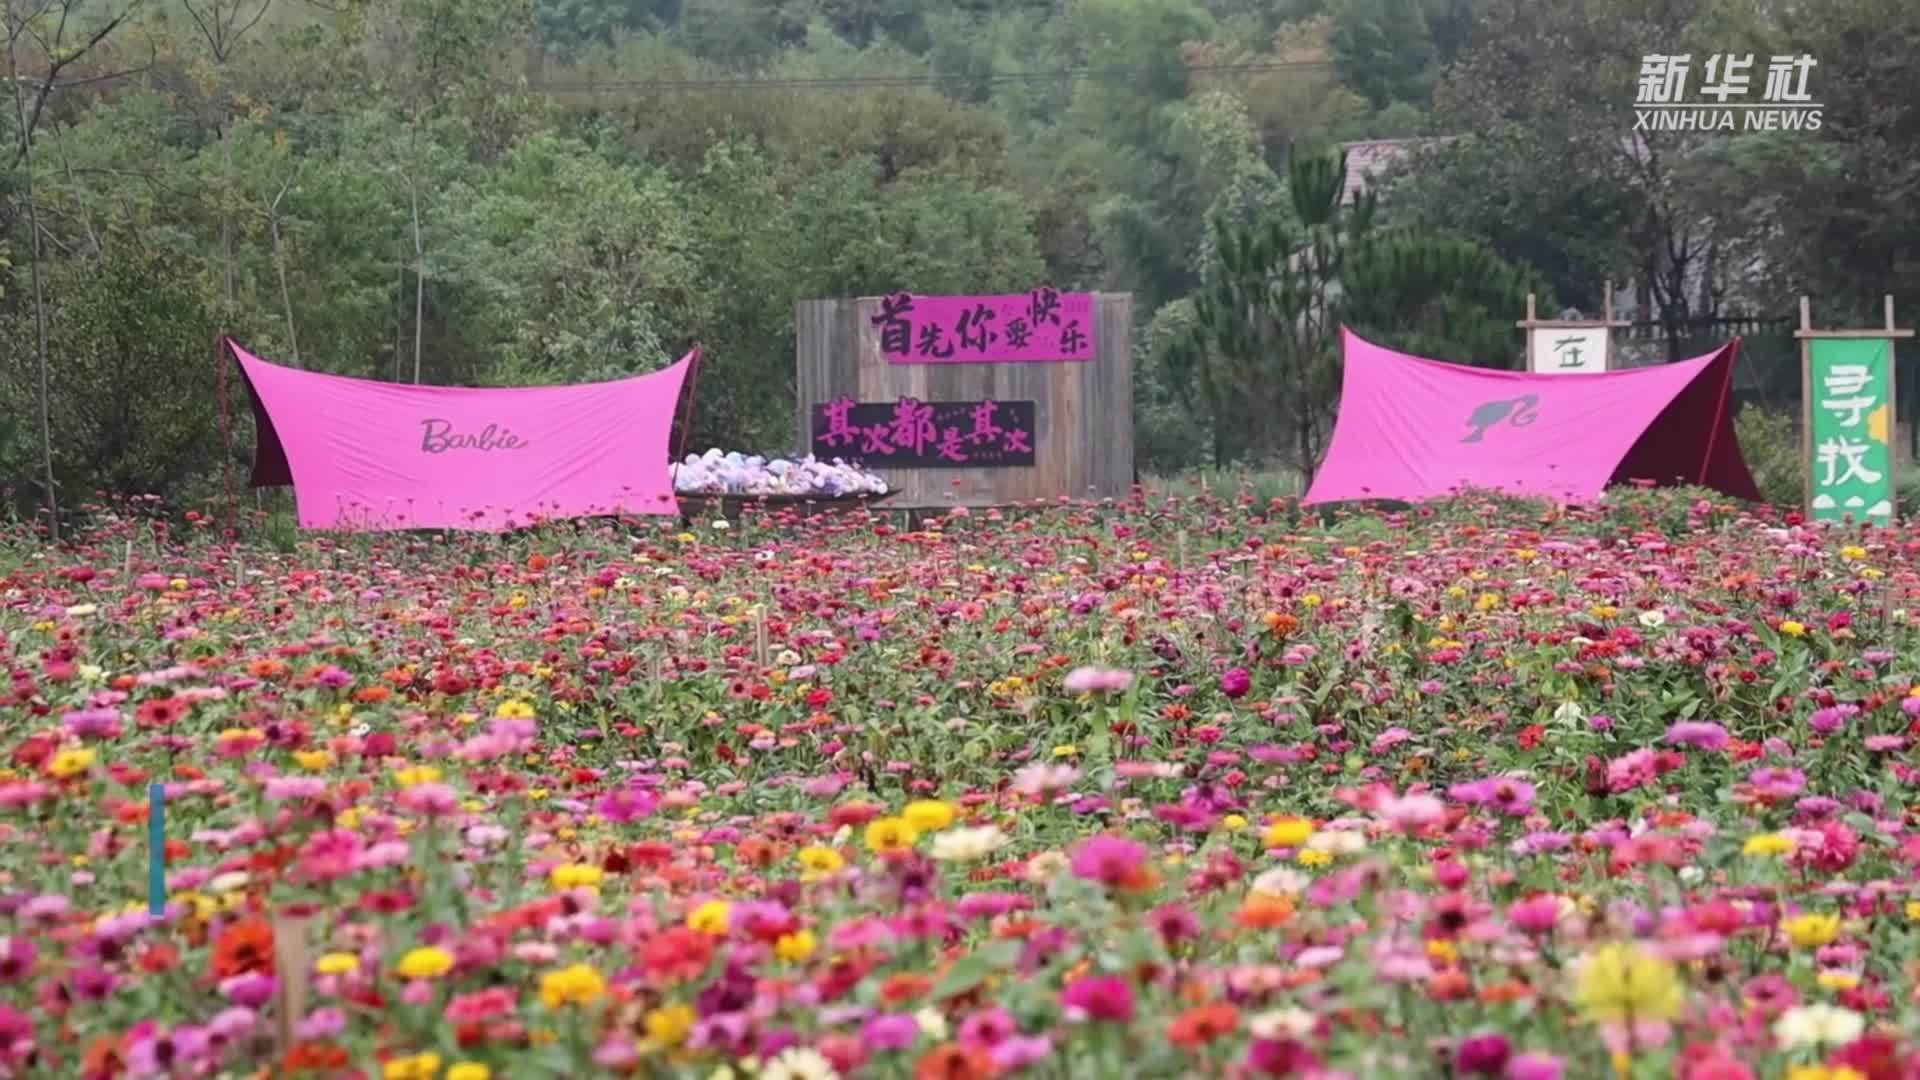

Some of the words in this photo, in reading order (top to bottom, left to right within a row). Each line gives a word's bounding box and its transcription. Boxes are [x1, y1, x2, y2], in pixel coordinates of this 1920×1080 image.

[872, 288, 1088, 357] 首先你要快乐
[1553, 336, 1586, 367] 在
[421, 418, 528, 453] Barbie
[817, 397, 1031, 460] 其次都是其次
[1817, 364, 1882, 486] 寻找
